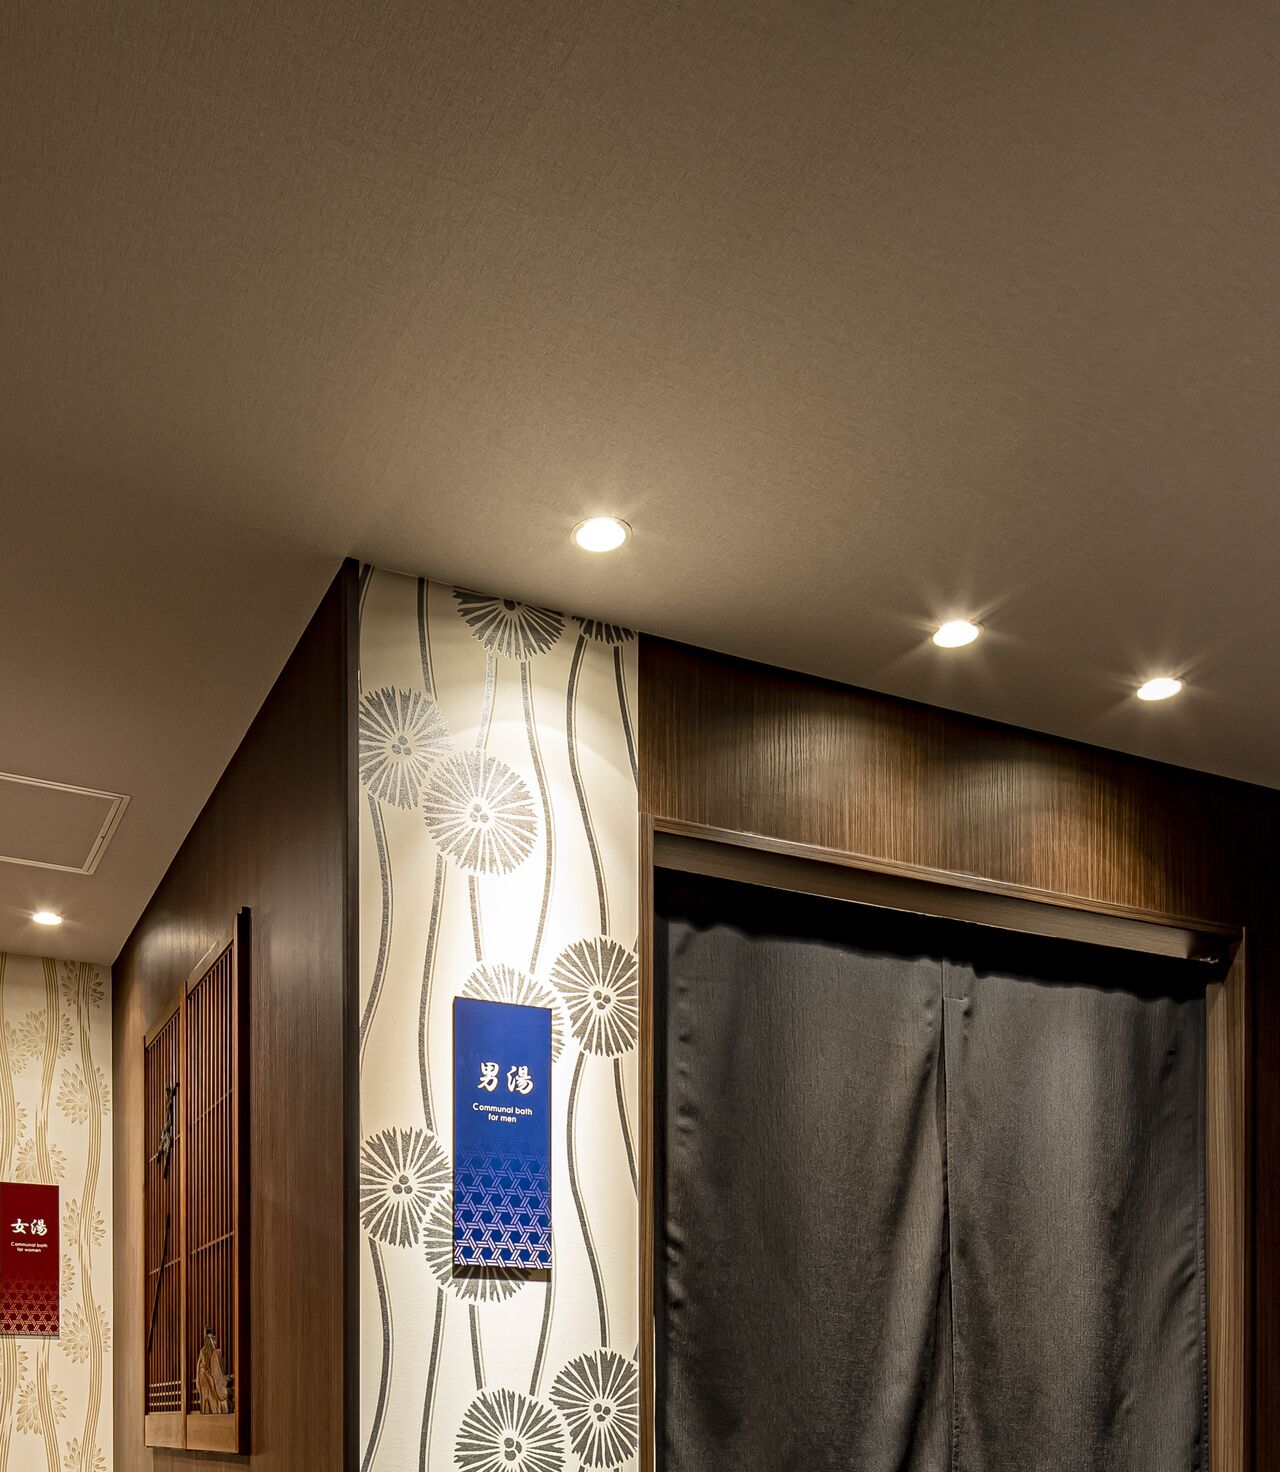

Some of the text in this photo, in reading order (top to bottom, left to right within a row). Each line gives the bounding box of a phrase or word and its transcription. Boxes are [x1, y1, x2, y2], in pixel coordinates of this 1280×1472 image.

[477, 1062, 534, 1095] 男湯
[472, 1102, 533, 1116] Communal bath
[488, 1113, 517, 1123] for men
[10, 1218, 48, 1236] 女湯
